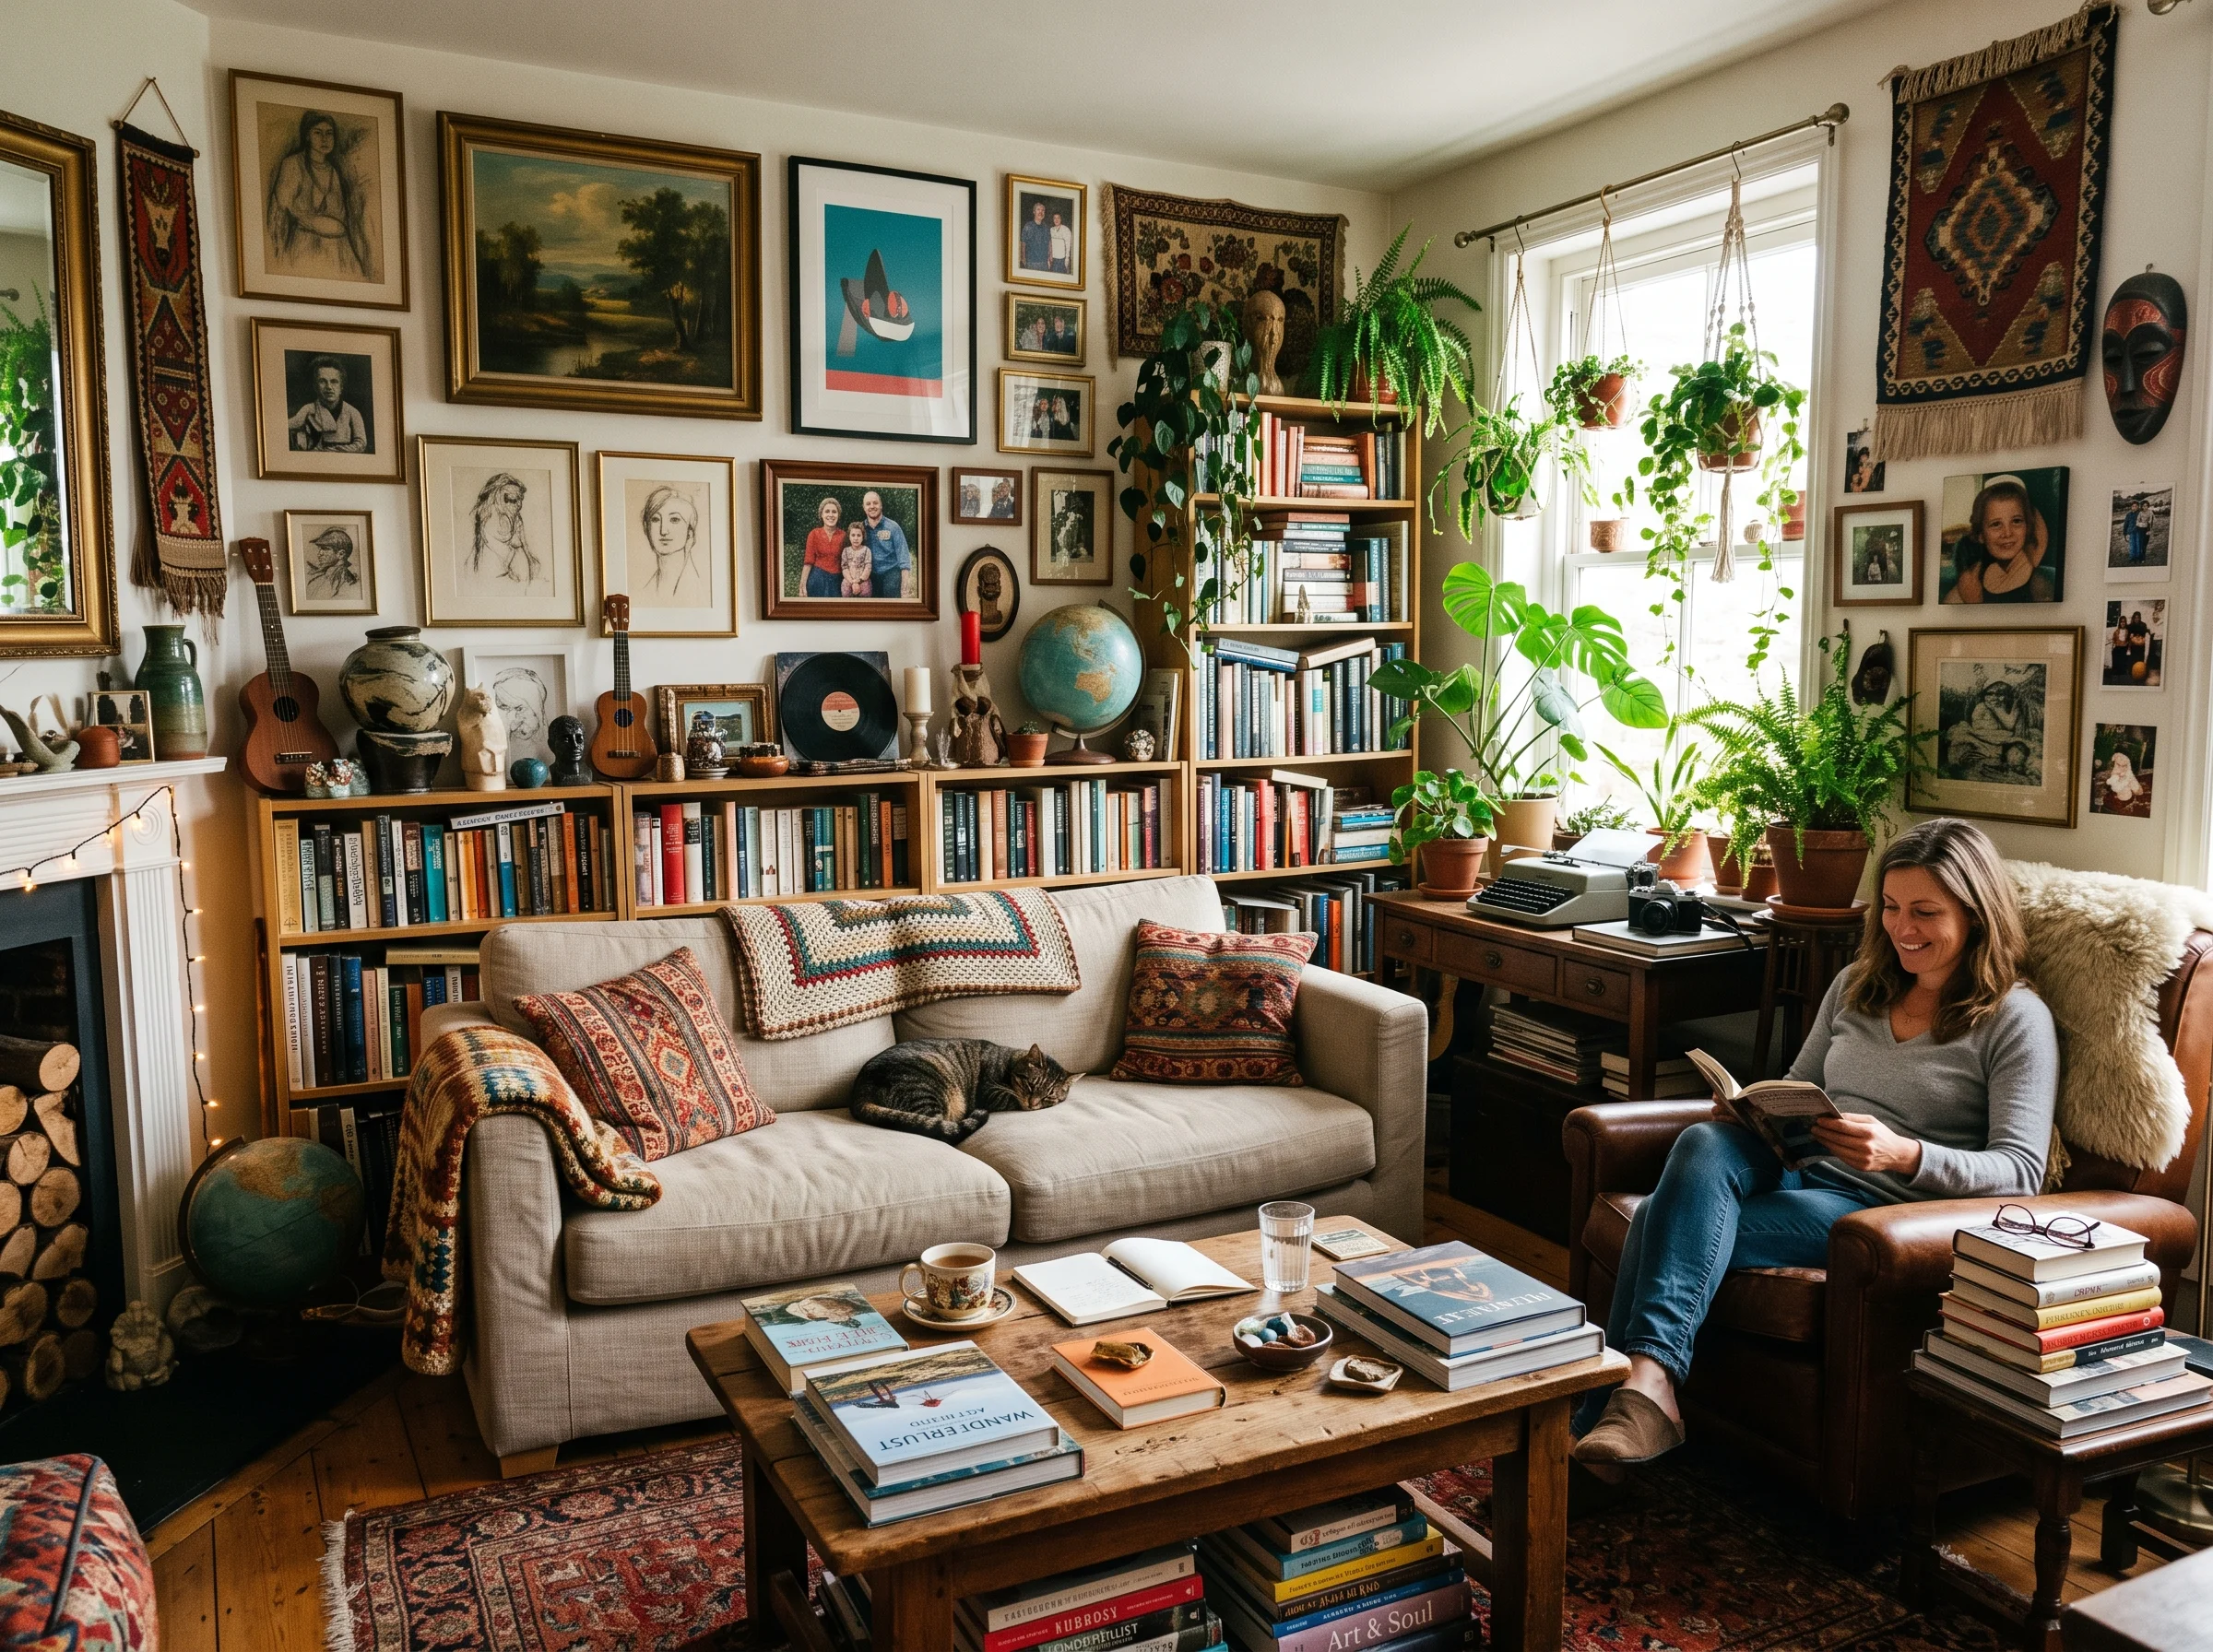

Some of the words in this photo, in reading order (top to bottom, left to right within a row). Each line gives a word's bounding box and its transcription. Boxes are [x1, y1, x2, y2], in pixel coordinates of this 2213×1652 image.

[1328, 1626, 1361, 1652] Art
[1367, 1617, 1383, 1639] &
[1388, 1600, 1433, 1634] Soul
